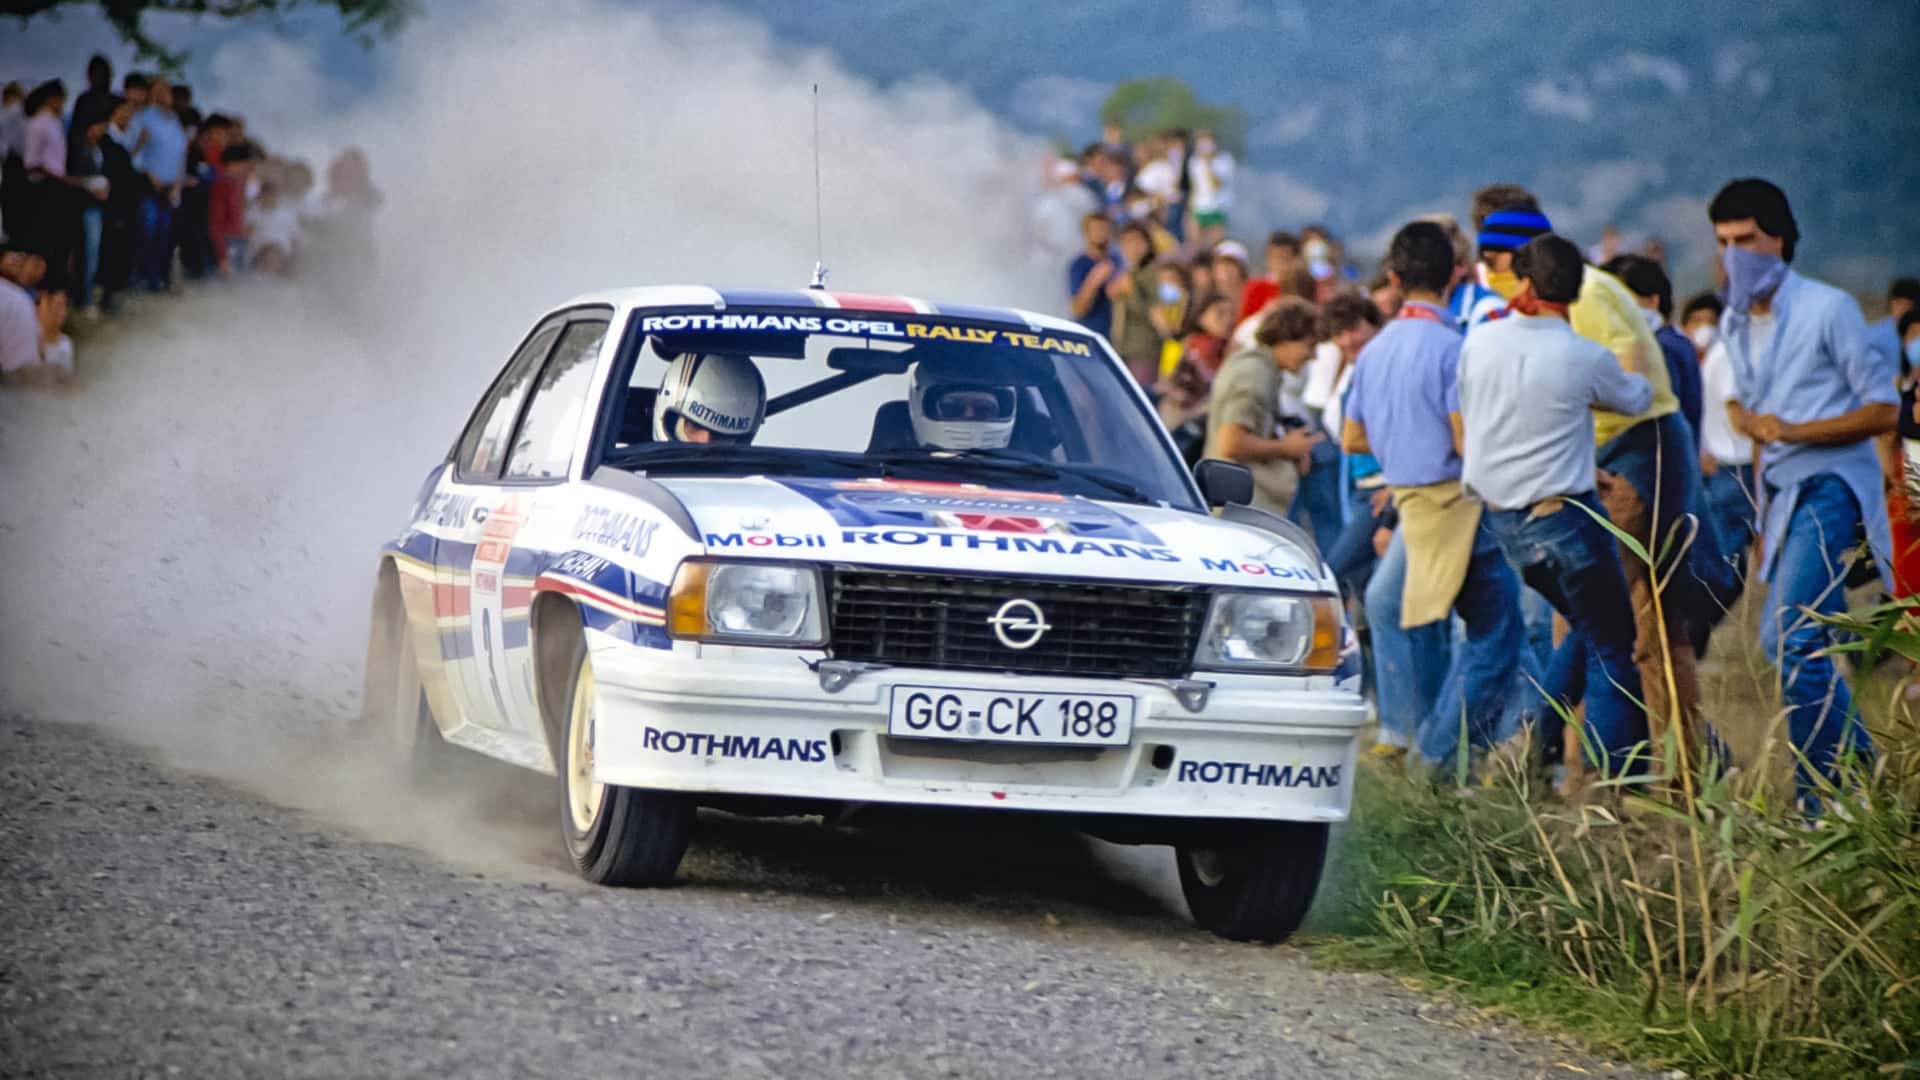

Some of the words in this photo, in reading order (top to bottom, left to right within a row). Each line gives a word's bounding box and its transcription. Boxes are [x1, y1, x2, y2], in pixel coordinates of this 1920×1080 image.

[641, 313, 823, 332] ROTHMANS
[825, 320, 904, 337] OPEL
[905, 323, 995, 345] RALLY
[1002, 331, 1091, 357] TEAM
[688, 400, 751, 430] ROTHMANS
[705, 532, 826, 548] Mobil
[841, 530, 1182, 563] ROTHMANS
[1200, 557, 1316, 581] Mobil
[905, 691, 1044, 737] GG-CK
[1058, 699, 1119, 738] 188
[643, 726, 827, 763] ROTHMANS
[1177, 759, 1342, 788] ROTHMANS
